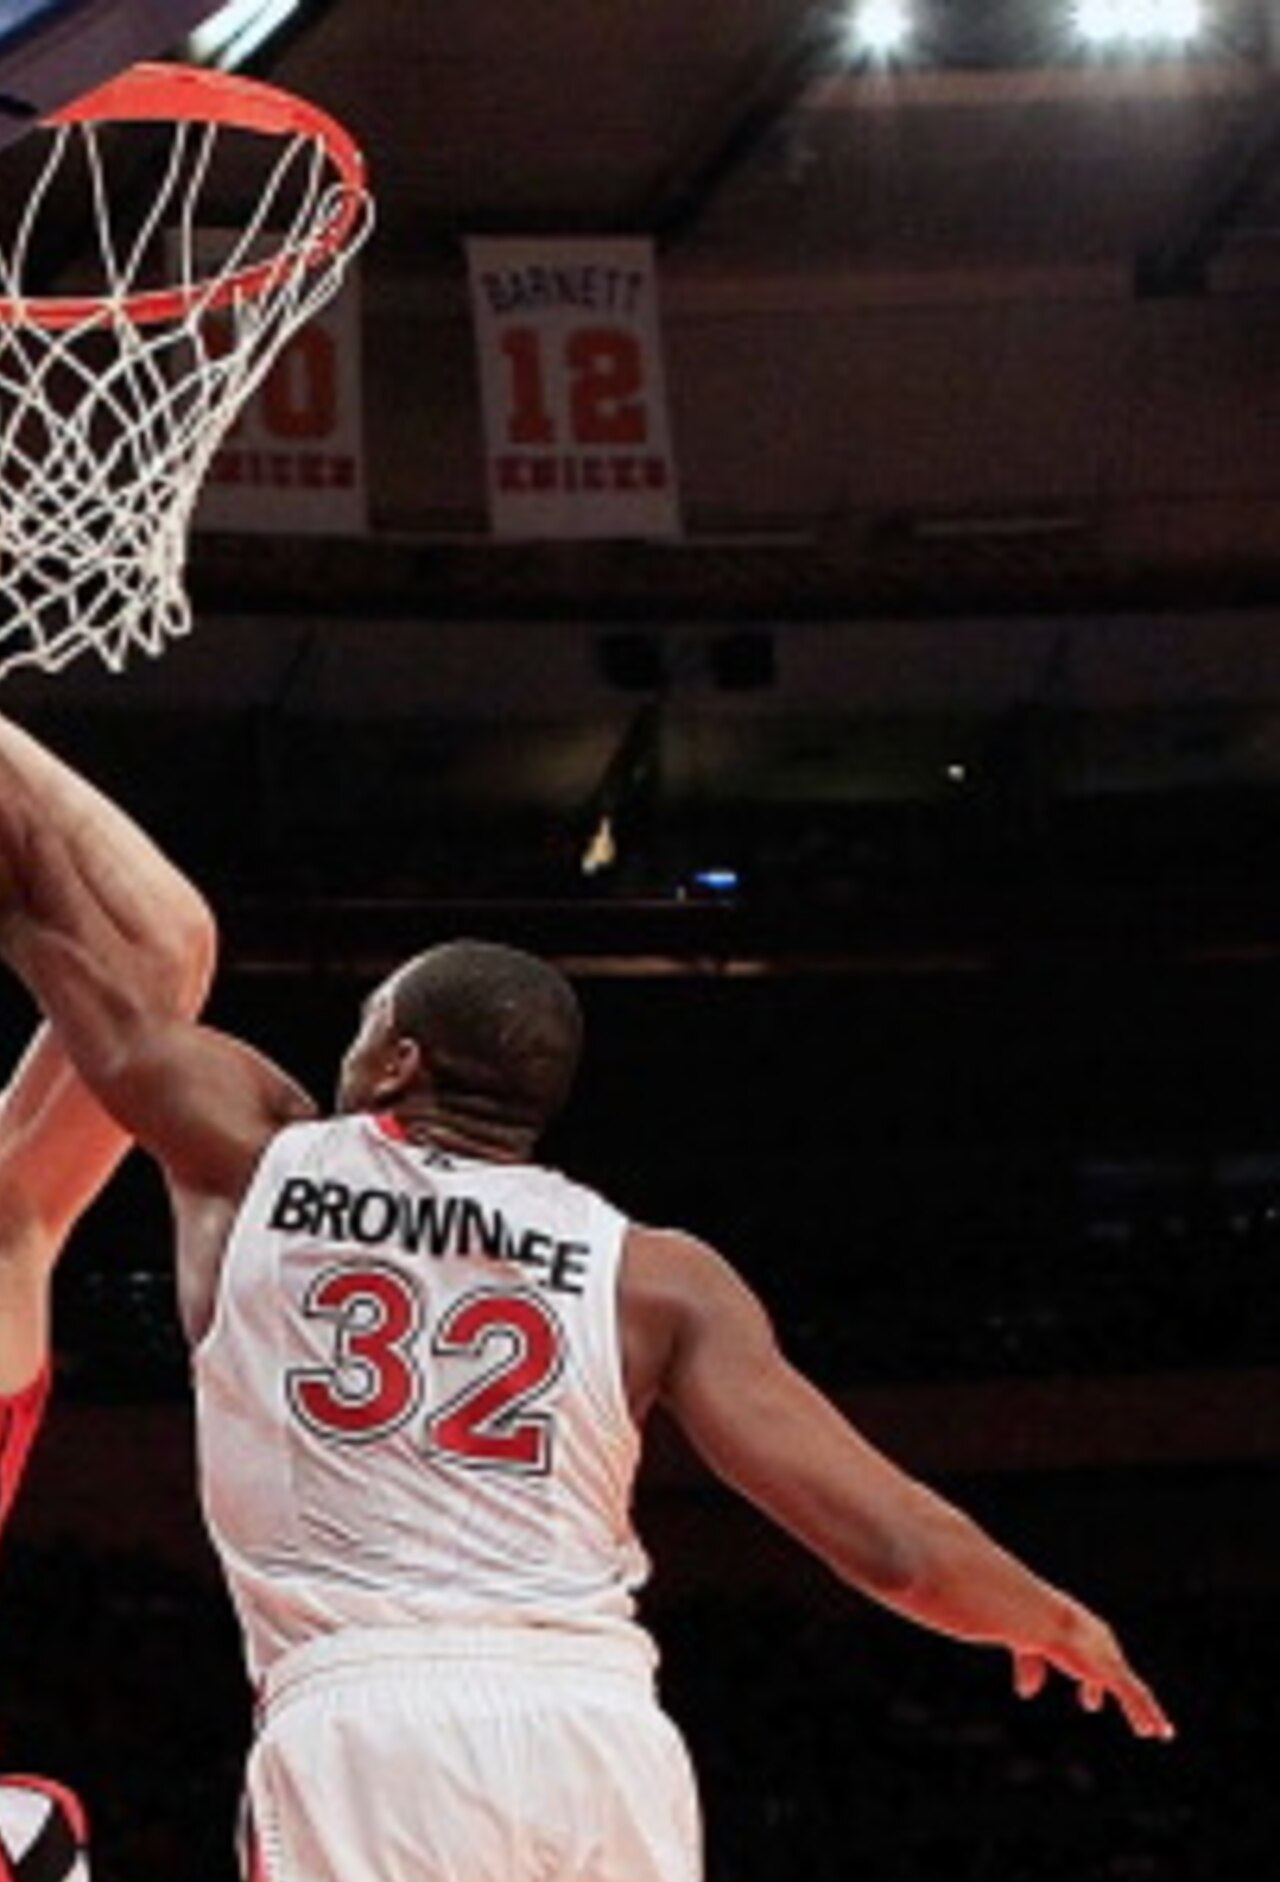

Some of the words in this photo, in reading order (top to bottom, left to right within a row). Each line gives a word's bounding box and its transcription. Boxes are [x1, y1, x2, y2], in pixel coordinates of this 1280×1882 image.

[480, 264, 643, 312] BARNETT
[499, 327, 648, 445] 12
[494, 454, 666, 491] KNICKS
[285, 1257, 566, 1478] 32
